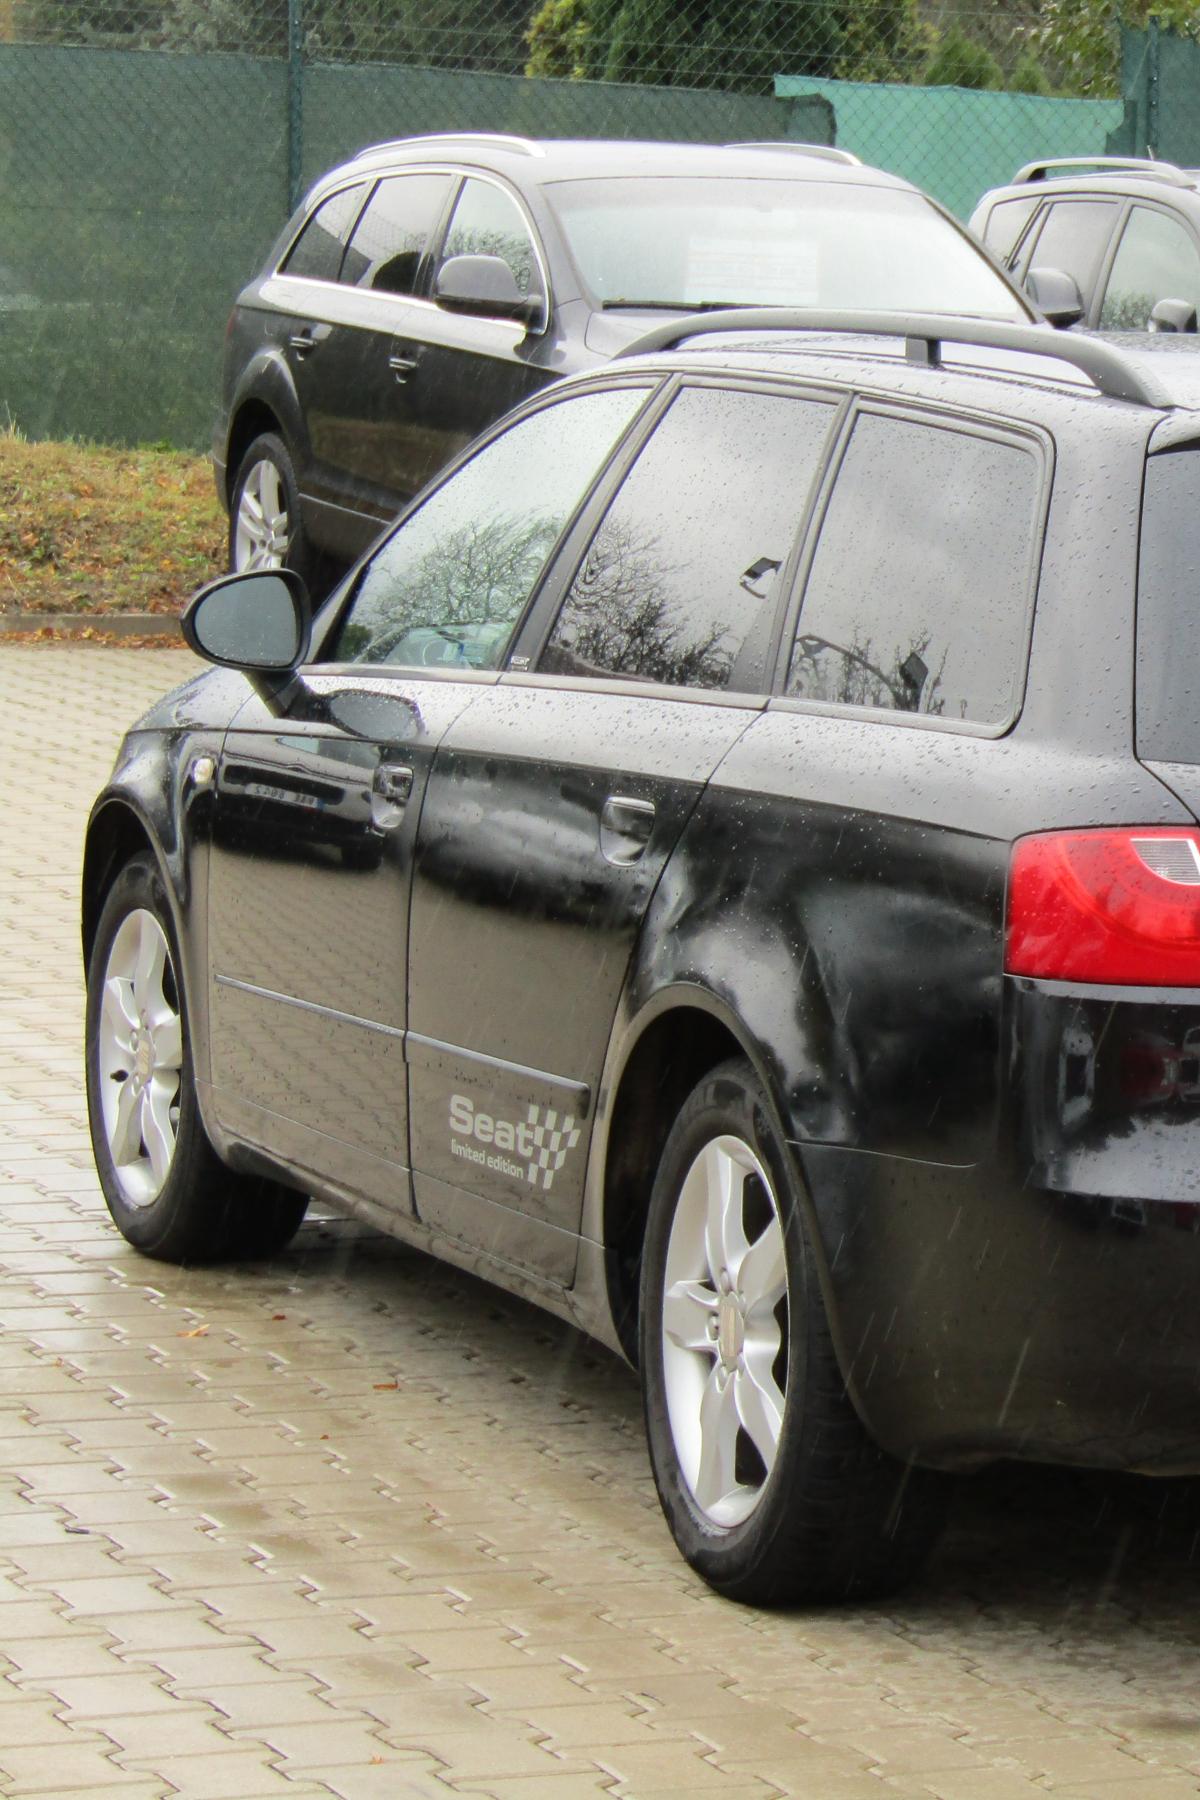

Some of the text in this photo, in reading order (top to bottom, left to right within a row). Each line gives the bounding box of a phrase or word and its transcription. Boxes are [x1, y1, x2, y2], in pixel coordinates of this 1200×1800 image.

[449, 1094, 534, 1158] Seat
[451, 1138, 524, 1180] limited edition
